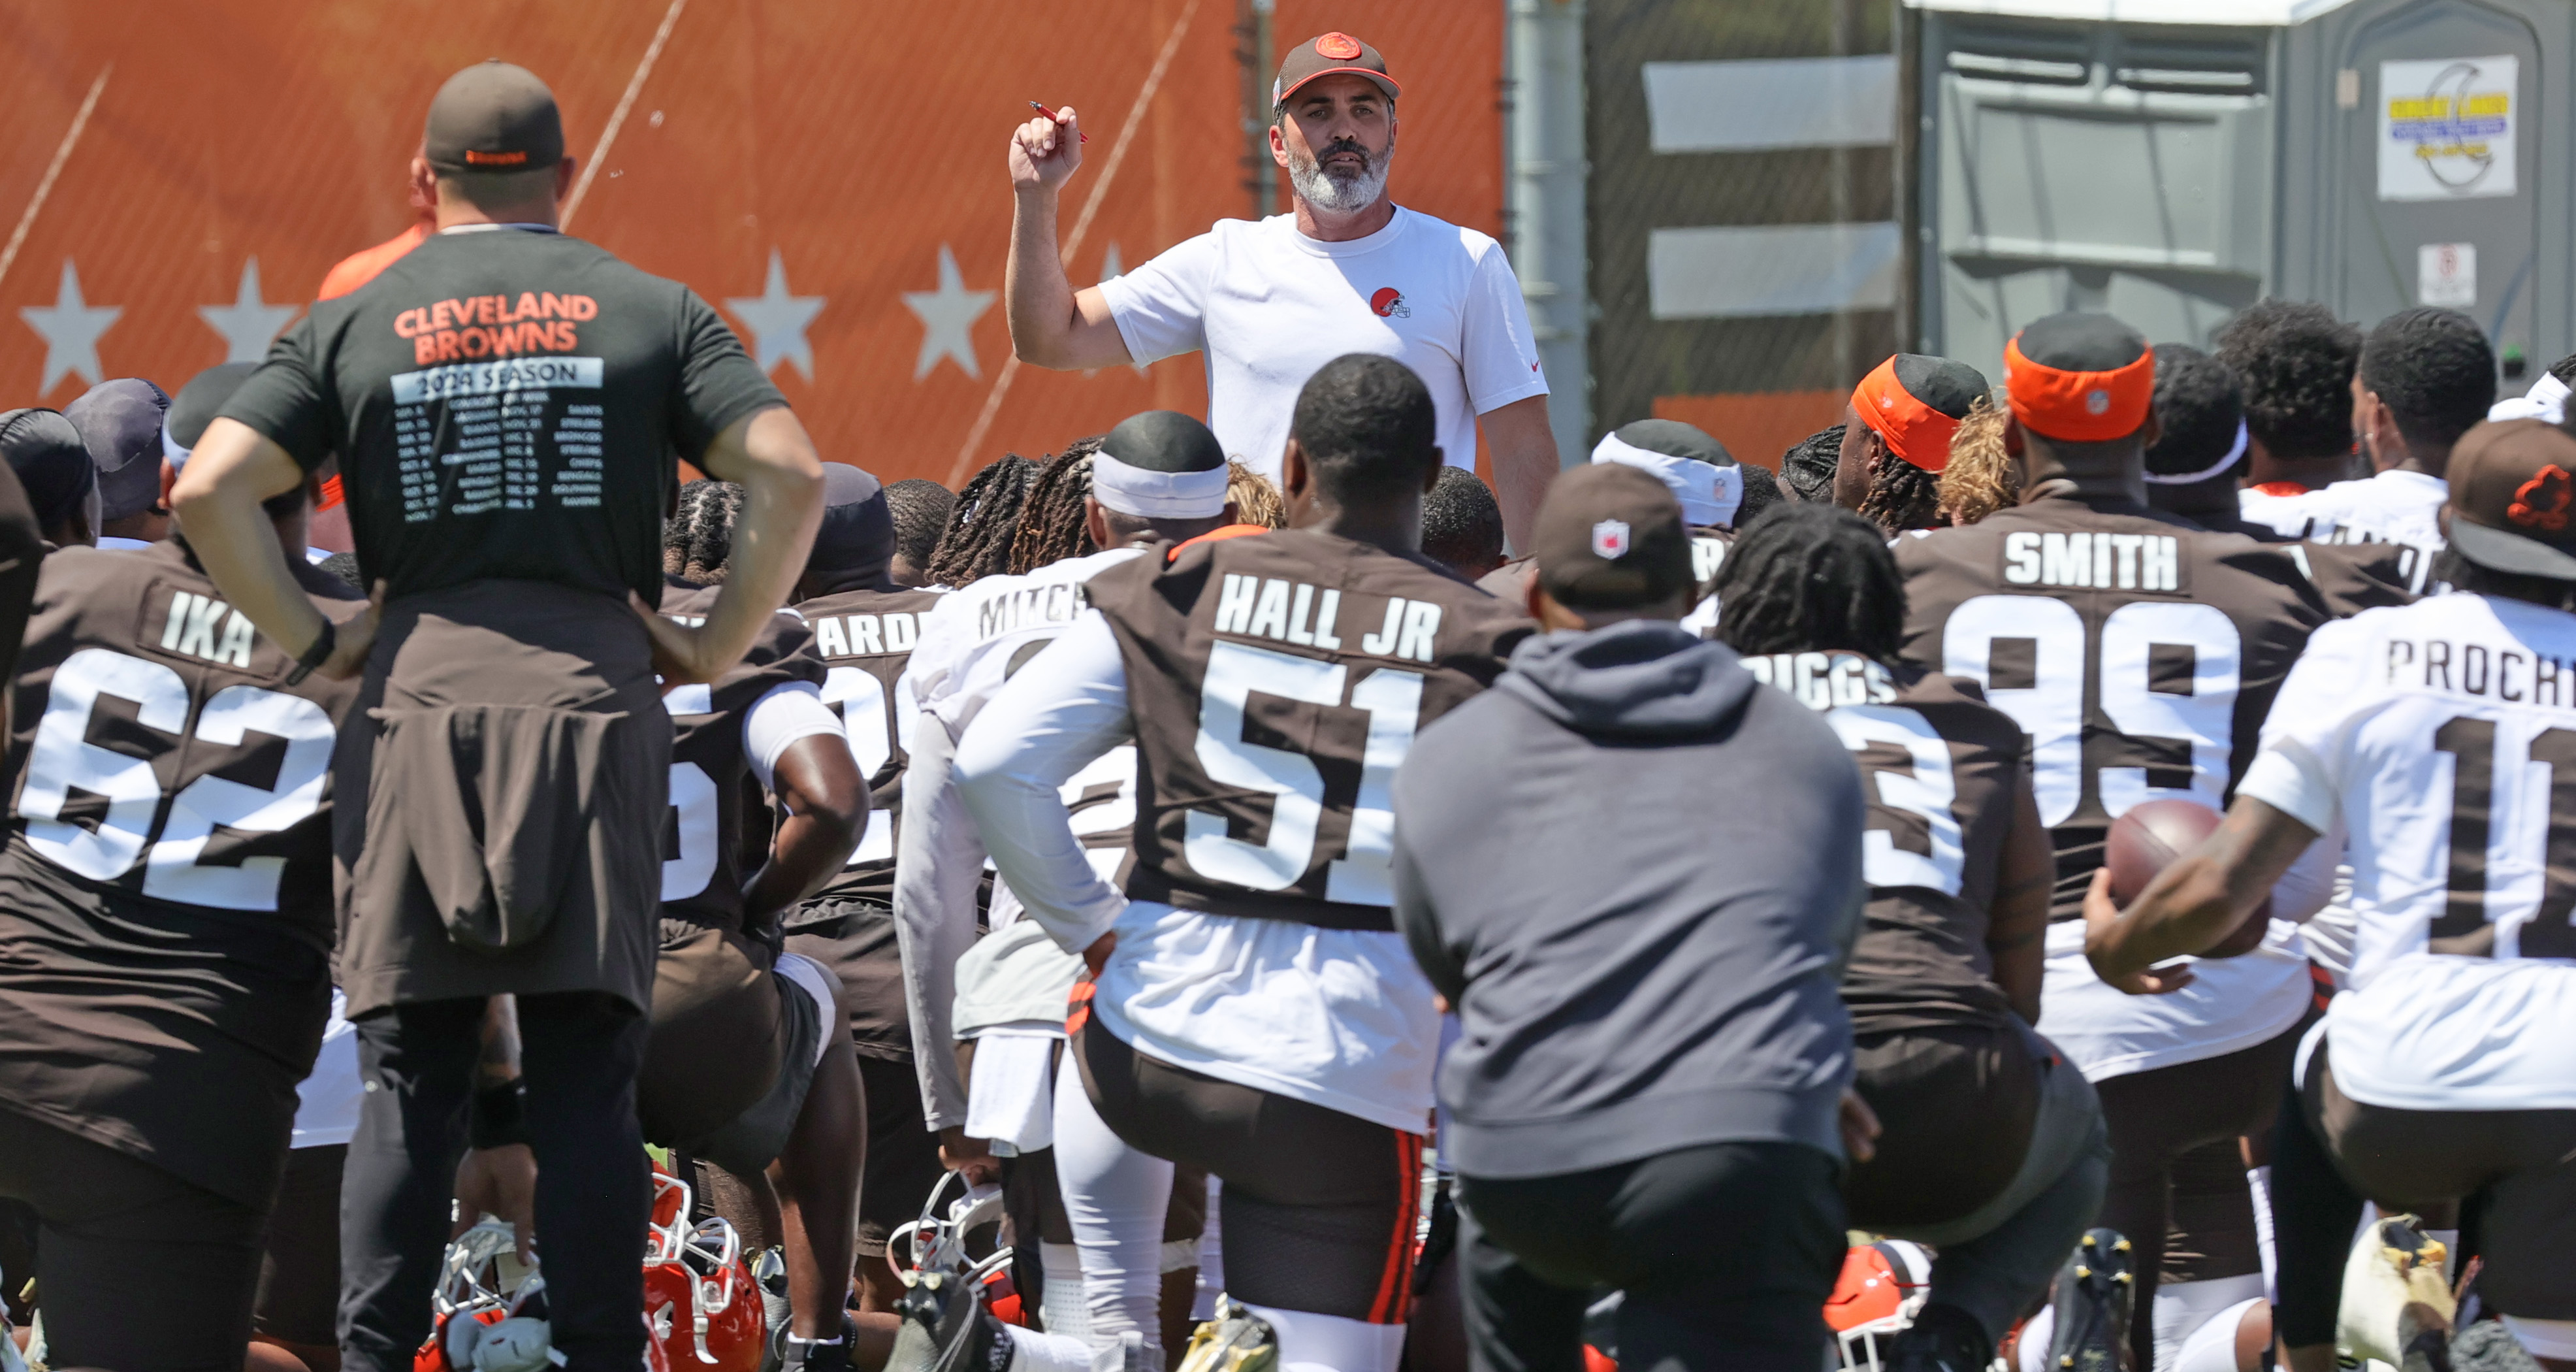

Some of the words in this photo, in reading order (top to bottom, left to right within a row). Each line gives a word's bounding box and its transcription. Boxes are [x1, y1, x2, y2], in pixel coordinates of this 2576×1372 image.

[394, 291, 599, 339] CLEVELAND
[414, 321, 578, 365] BROWNS
[415, 370, 473, 395] 2024
[483, 362, 577, 389] SEASON
[2005, 532, 2178, 591] SMITH
[161, 591, 255, 668] IKA
[817, 612, 934, 657] ARD
[1214, 573, 1341, 650] HALL
[1362, 597, 1441, 662] JR
[2388, 639, 2576, 708] PROCH
[1942, 595, 2241, 828] 99
[18, 648, 336, 911] 62
[1184, 639, 1424, 907] 51
